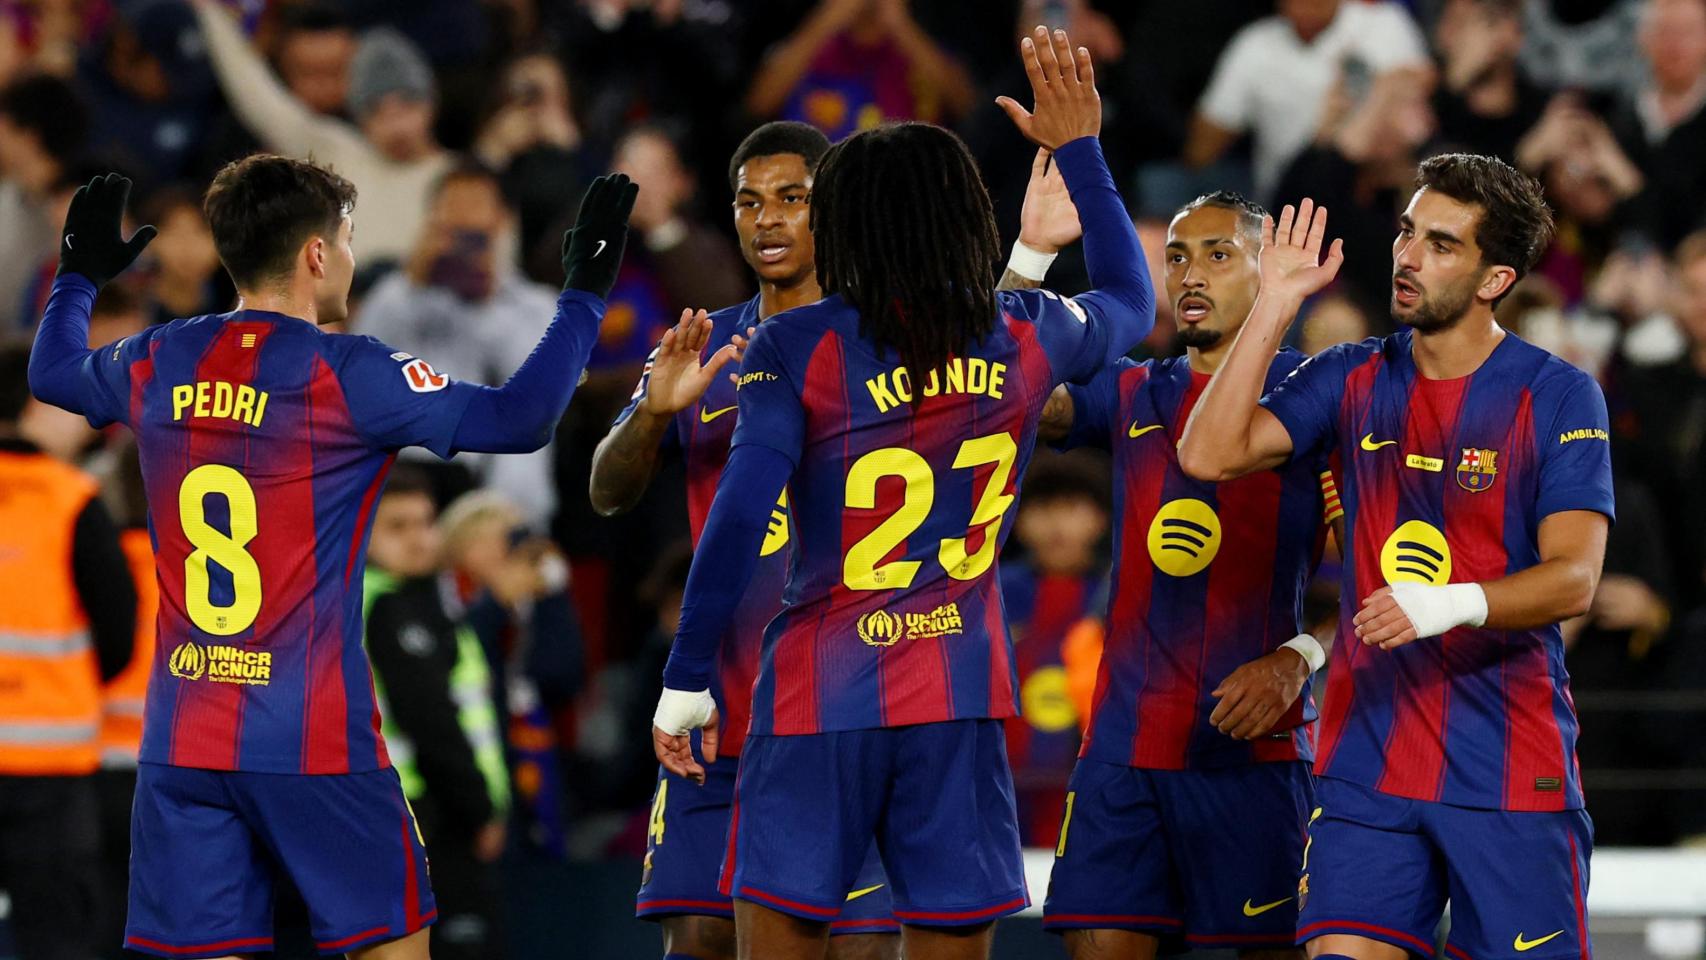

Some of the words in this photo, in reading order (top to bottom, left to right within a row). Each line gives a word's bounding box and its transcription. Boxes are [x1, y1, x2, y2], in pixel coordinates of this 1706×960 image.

[766, 373, 778, 381] tv
[172, 381, 269, 428] PEDRI
[843, 431, 1017, 590] 23
[178, 463, 262, 636] 8
[206, 645, 272, 666] UNHCR
[208, 661, 271, 679] ACNUR
[648, 778, 668, 845] 4
